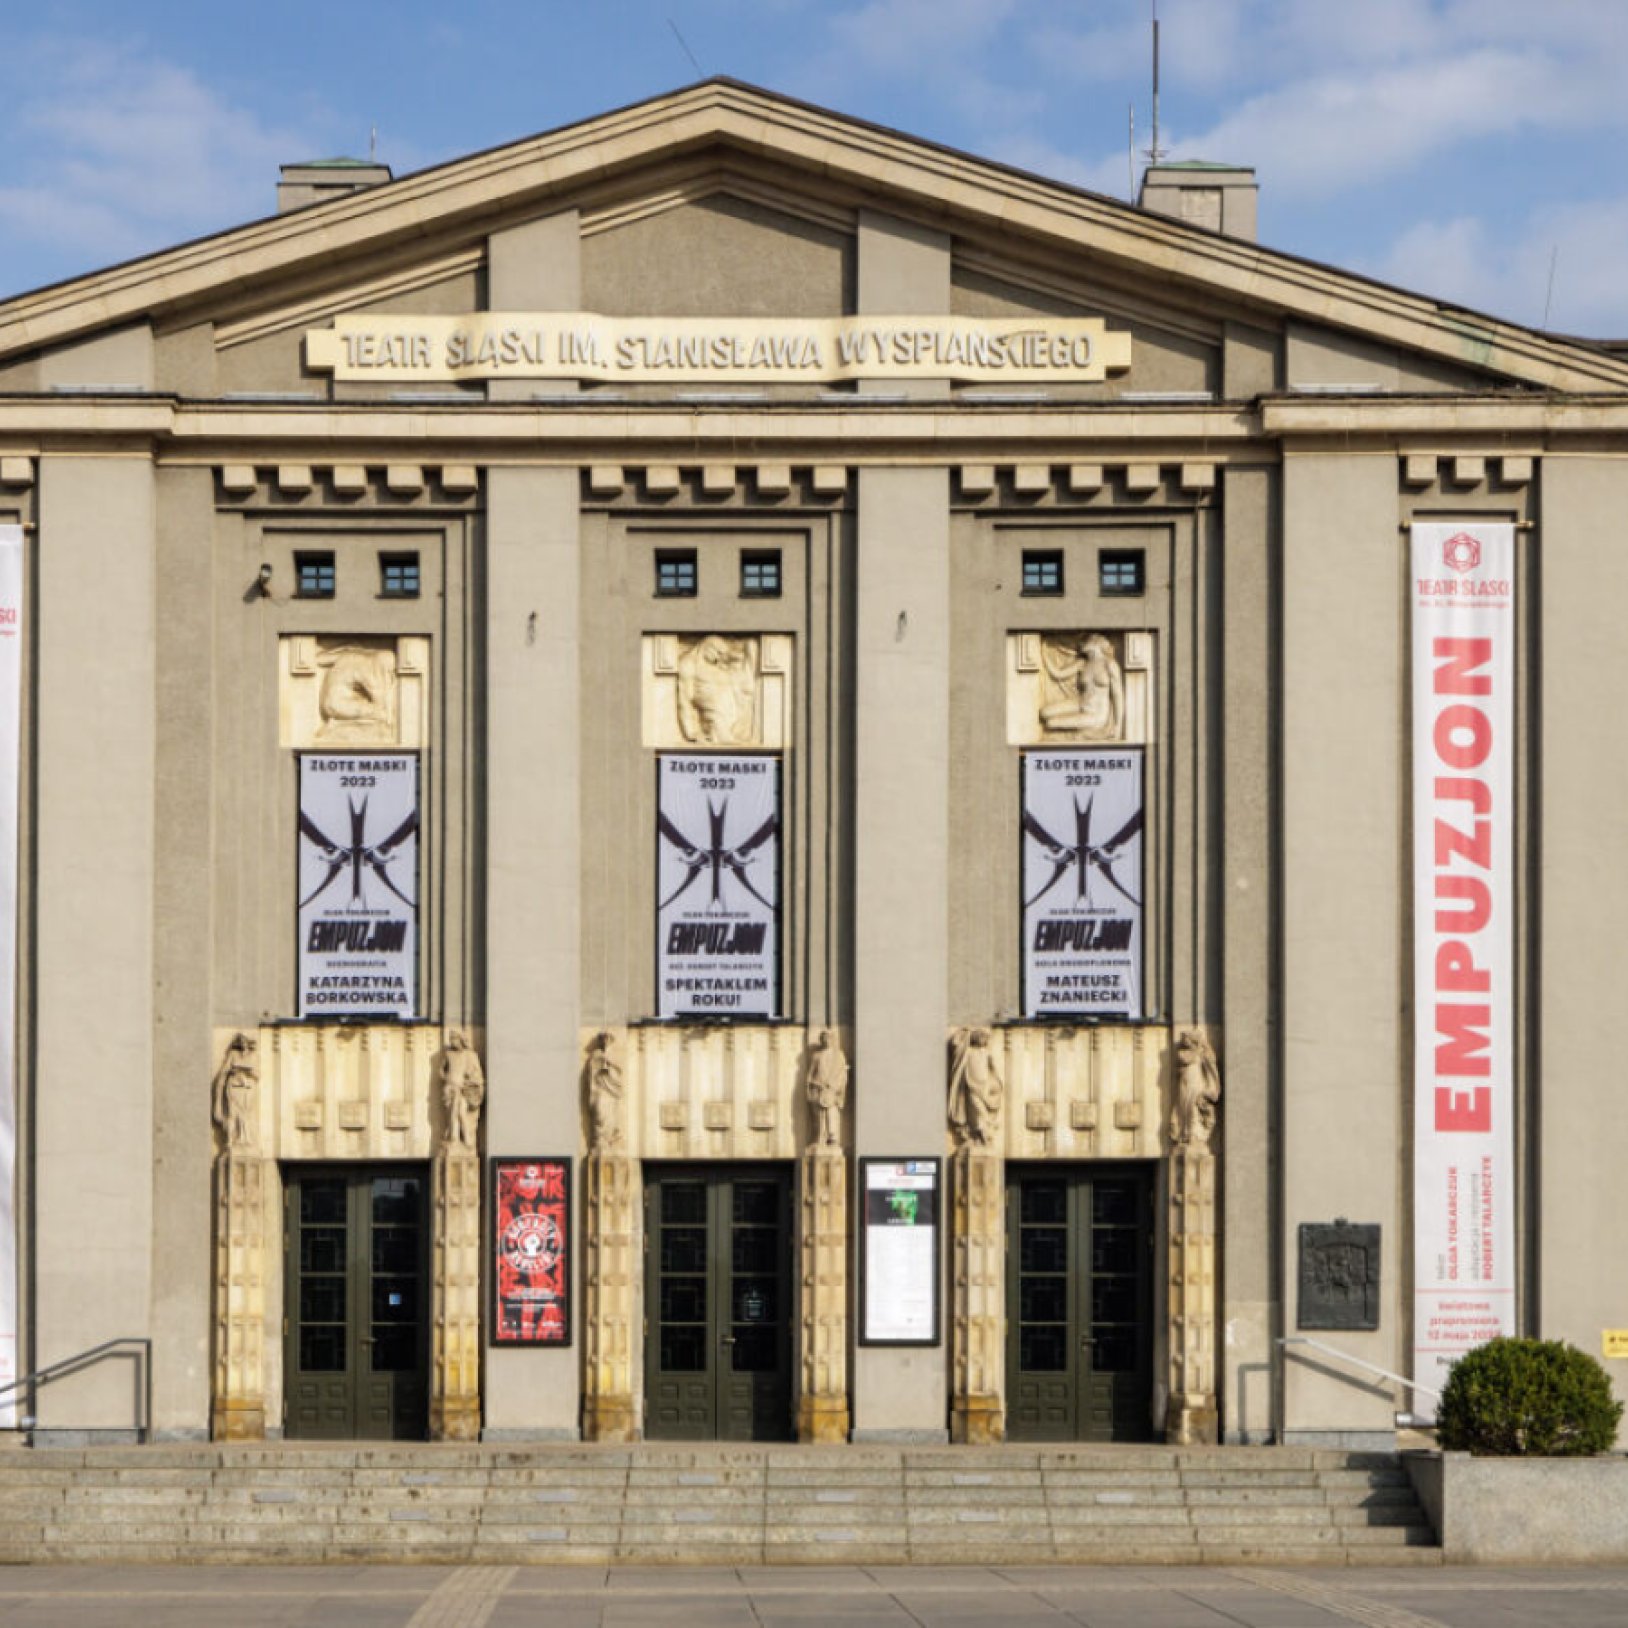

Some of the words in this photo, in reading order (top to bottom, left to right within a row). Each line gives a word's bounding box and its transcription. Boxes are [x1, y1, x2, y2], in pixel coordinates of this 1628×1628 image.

[341, 331, 431, 368] TEATR
[558, 326, 608, 369] IM.
[616, 335, 823, 370] STANISŁAWA
[358, 760, 407, 772] MASKI
[718, 761, 767, 774] MASKI
[1083, 759, 1132, 771] MASKI
[339, 776, 376, 788] 2023
[699, 778, 735, 790] 2023
[1065, 775, 1102, 786] 2023
[1433, 637, 1492, 1132] EMPUZJON
[309, 976, 404, 989] KATARZYNA
[665, 978, 767, 991] SPEKTAKLEM
[1046, 975, 1121, 988] MATEUSZ
[305, 992, 408, 1005] BORKOWSKA
[692, 994, 741, 1007] ROKU!
[1040, 991, 1127, 1004] ZNANIECKI
